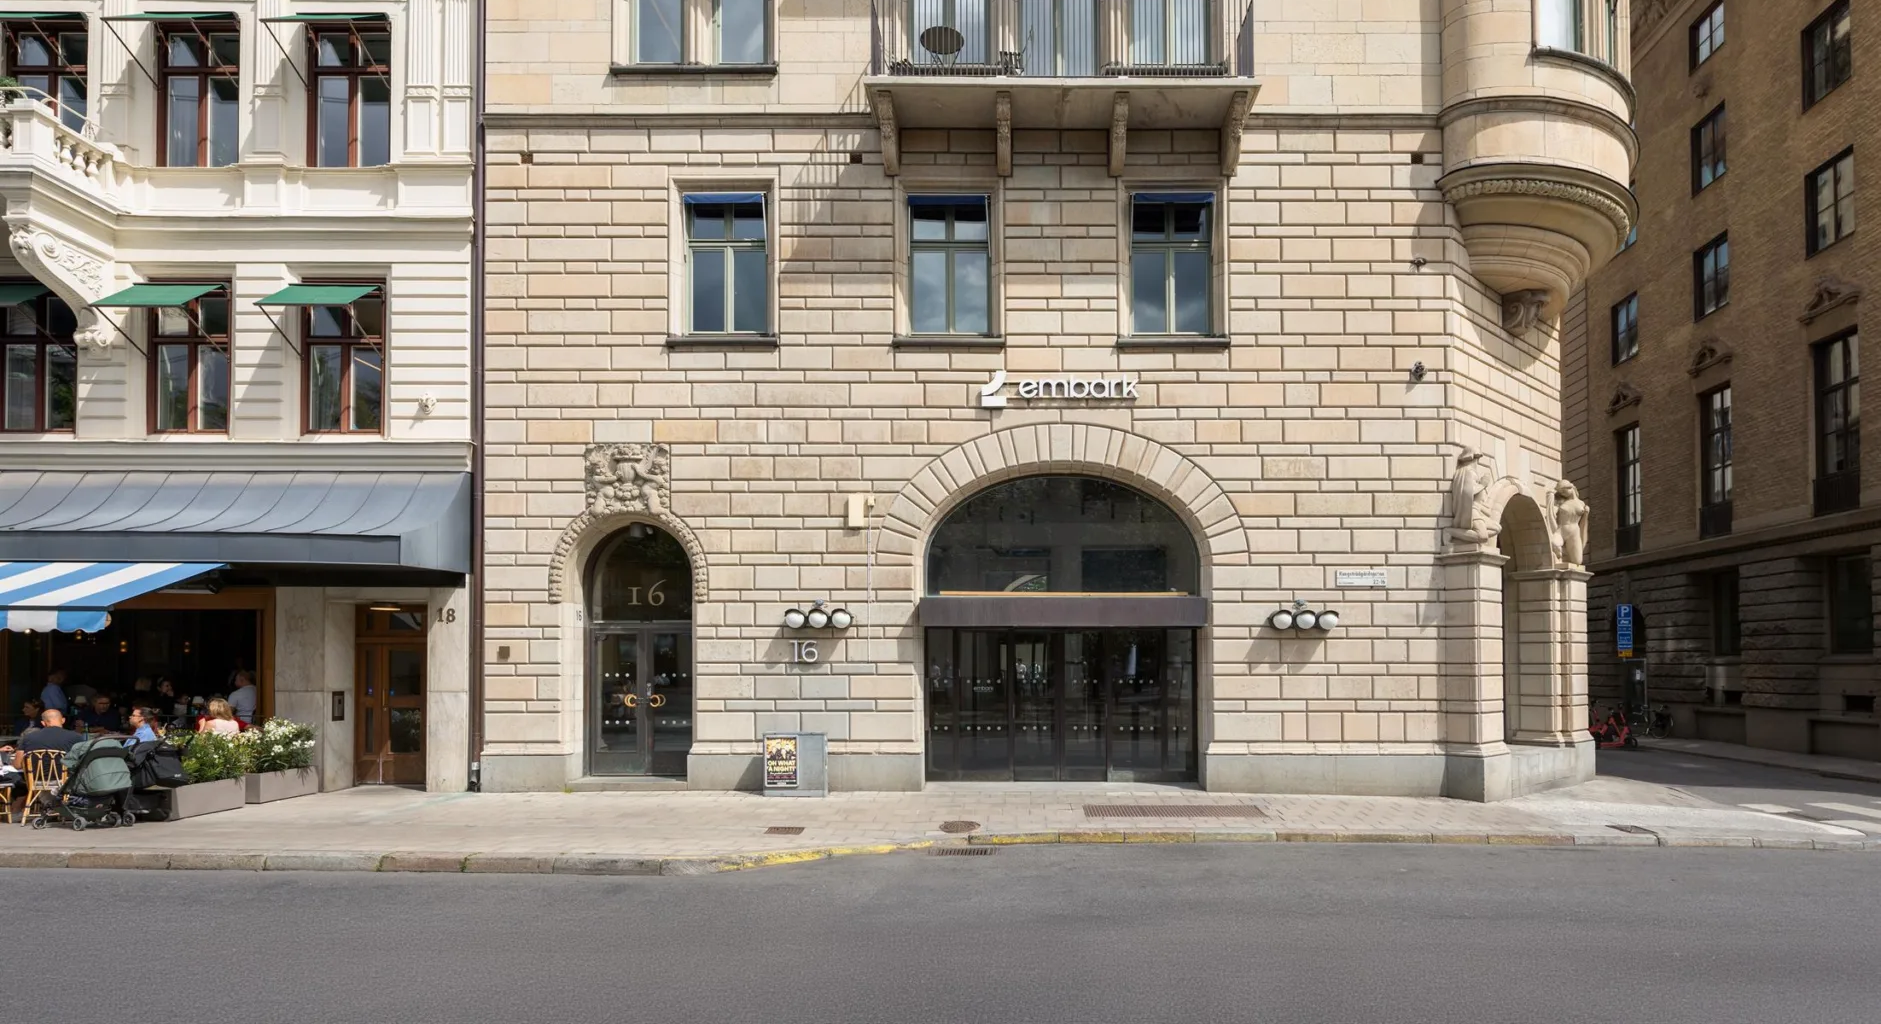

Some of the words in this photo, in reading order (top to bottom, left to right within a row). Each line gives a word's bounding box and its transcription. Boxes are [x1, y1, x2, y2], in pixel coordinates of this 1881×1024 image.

[1018, 373, 1140, 399] embark
[627, 579, 667, 607] 16
[436, 607, 456, 623] 18
[1620, 606, 1630, 618] P
[789, 640, 818, 663] 16
